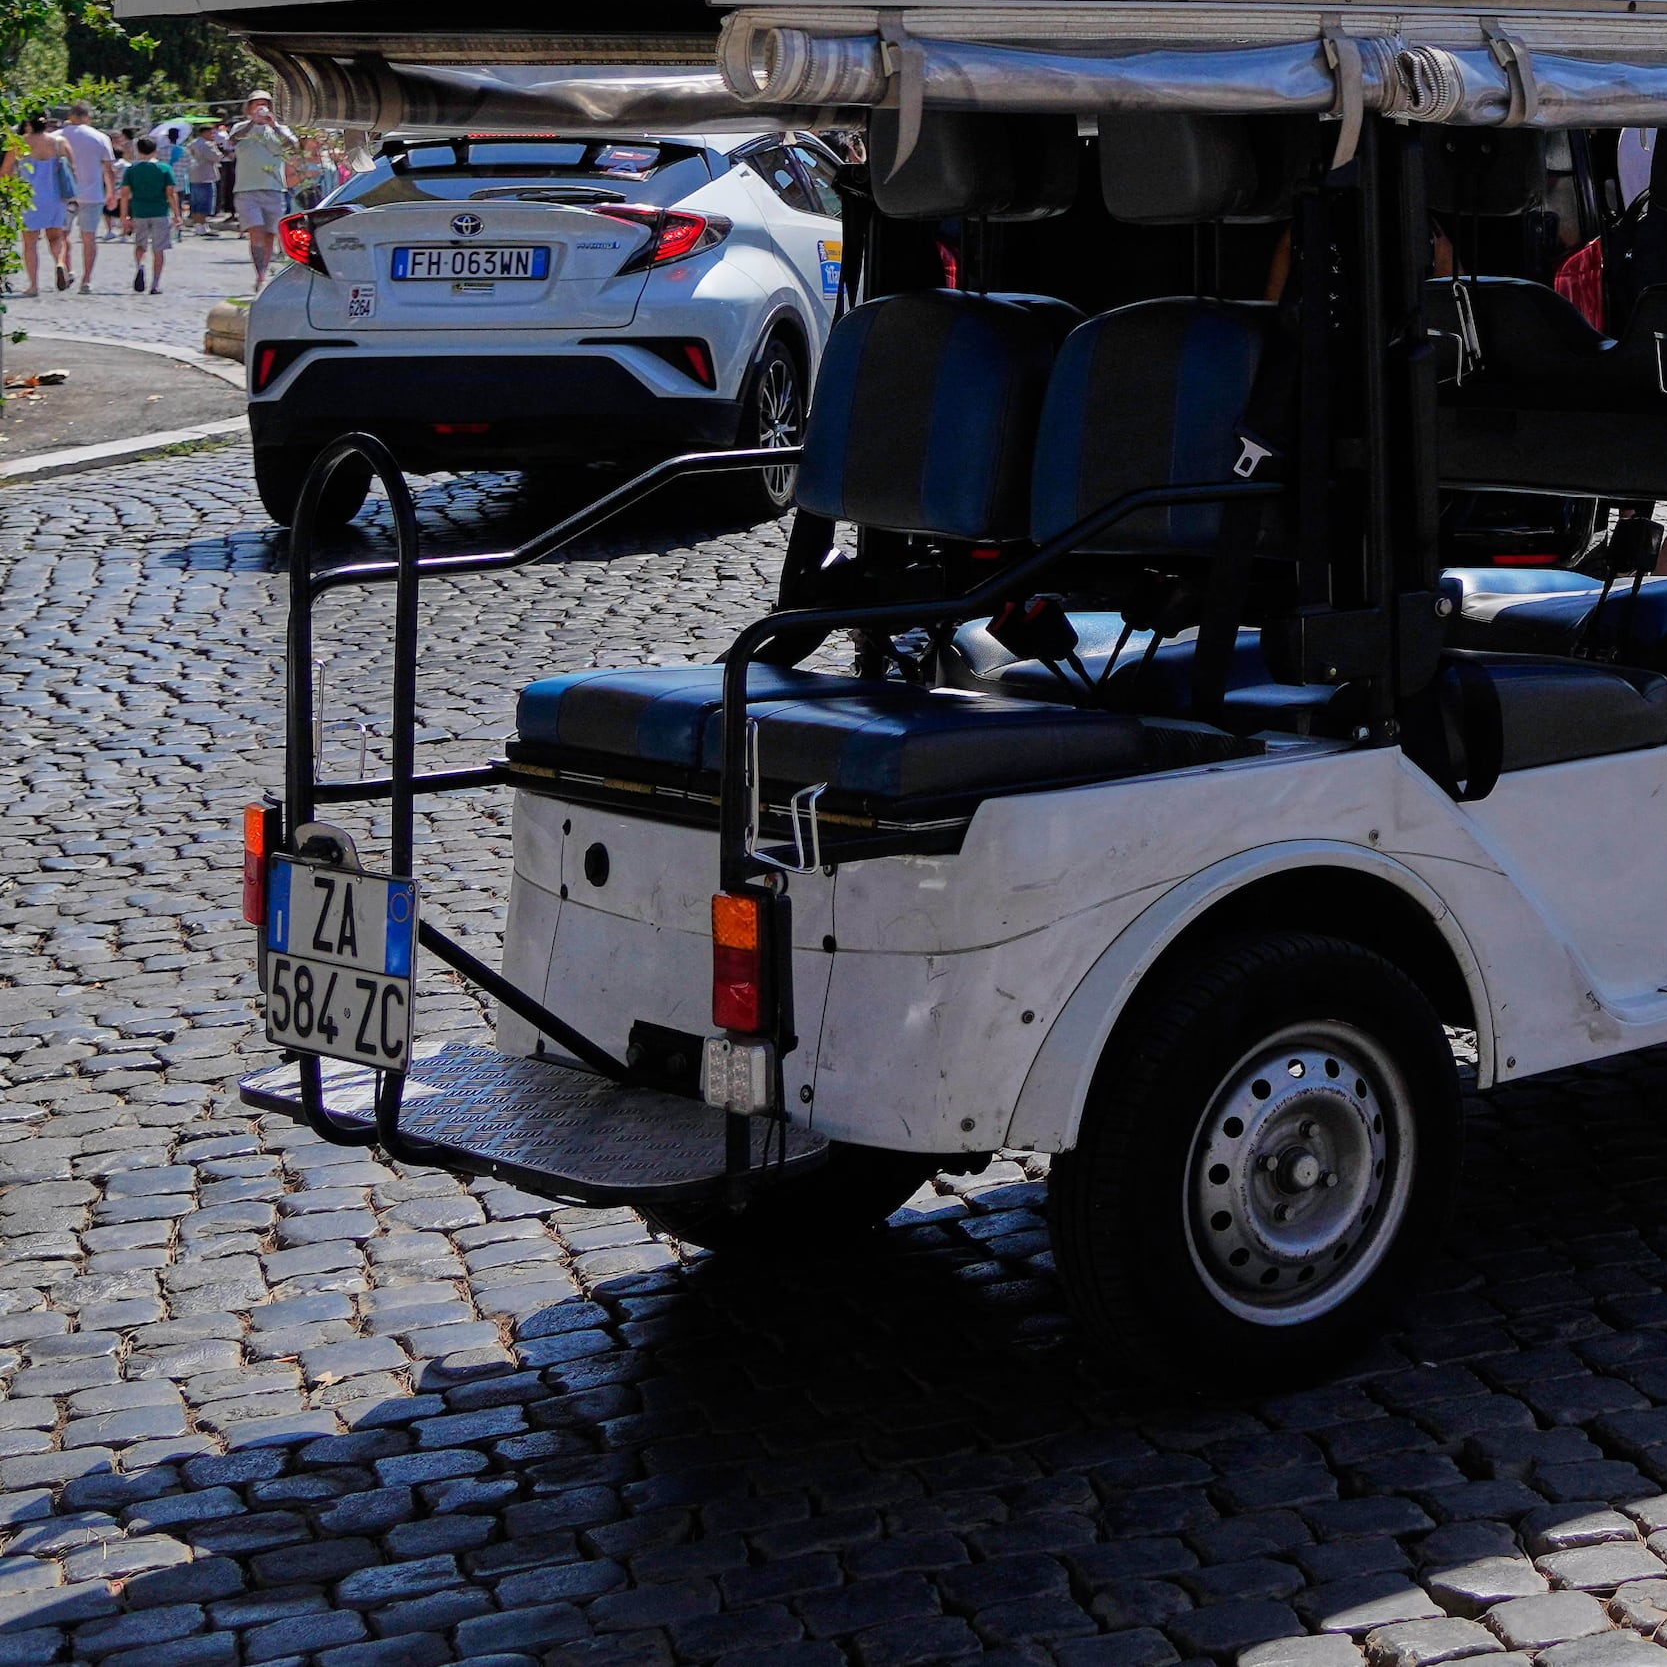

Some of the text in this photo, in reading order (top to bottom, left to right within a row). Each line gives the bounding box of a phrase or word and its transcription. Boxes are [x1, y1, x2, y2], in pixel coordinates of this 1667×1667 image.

[410, 251, 441, 276] FH
[451, 250, 530, 276] 063WN
[312, 876, 358, 959] ZA
[272, 958, 405, 1059] 584 ZC
